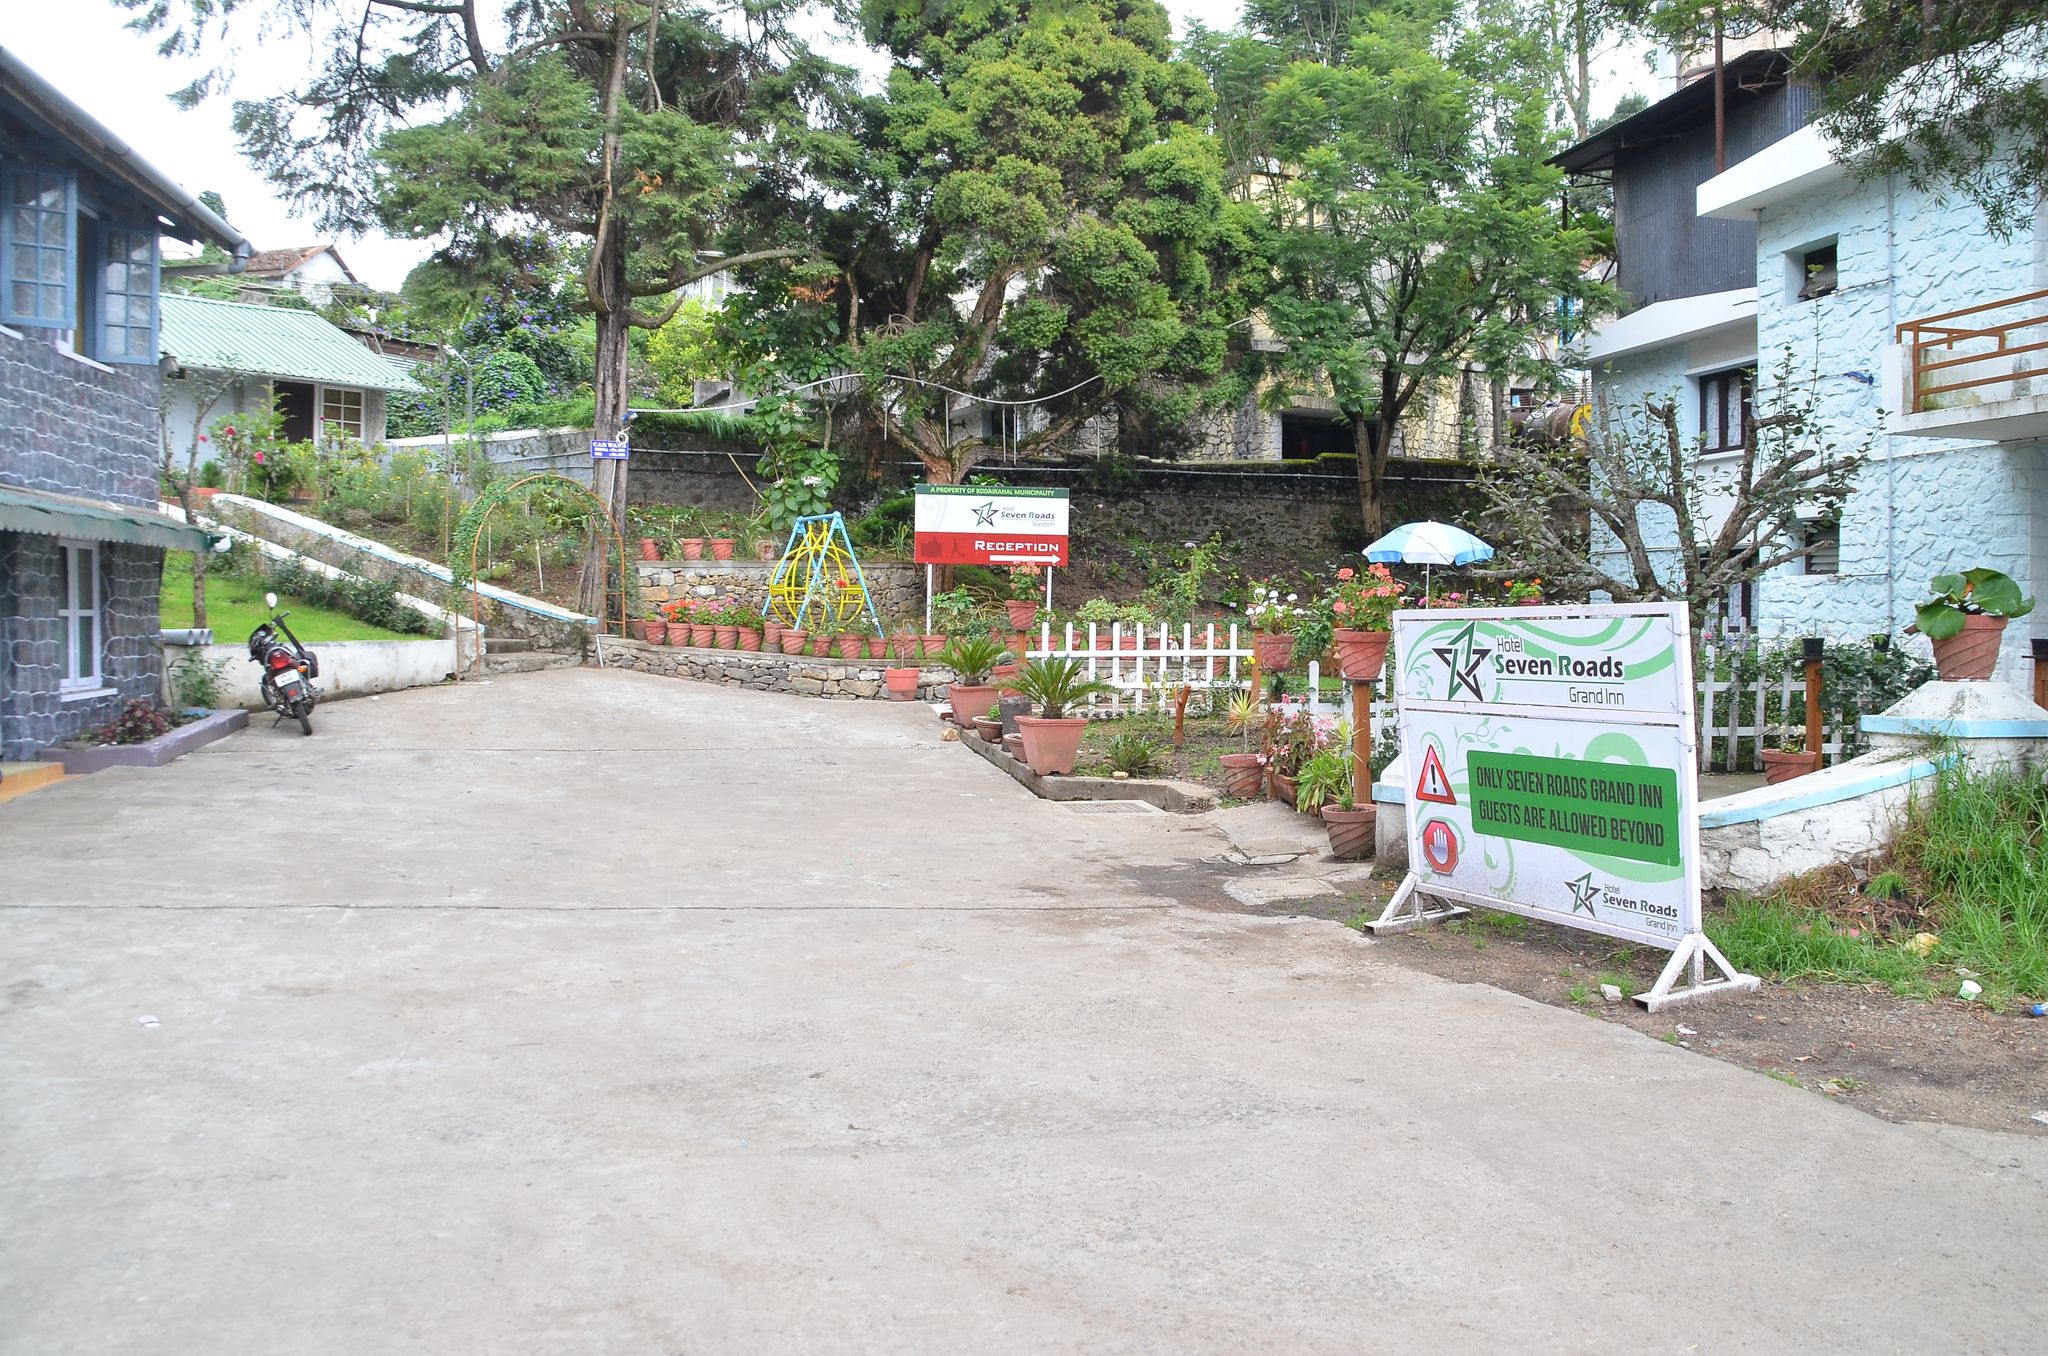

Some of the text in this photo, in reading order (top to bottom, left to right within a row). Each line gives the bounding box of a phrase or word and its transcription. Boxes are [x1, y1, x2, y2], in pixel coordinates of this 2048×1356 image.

[974, 540, 1059, 552] RECEPTION
[1497, 637, 1523, 652] Hotel
[1495, 654, 1624, 678] Seven Roads
[1569, 686, 1624, 705] Grand Inn
[1476, 766, 1663, 809] ONLY SEVEN ROADS GRAND INN
[1479, 800, 1664, 847] GUESTS ARE ALLOWED BEYOND
[1604, 883, 1620, 894] Hotel
[1602, 893, 1678, 918] Seven Roads
[1645, 917, 1678, 932] Grand Inn
